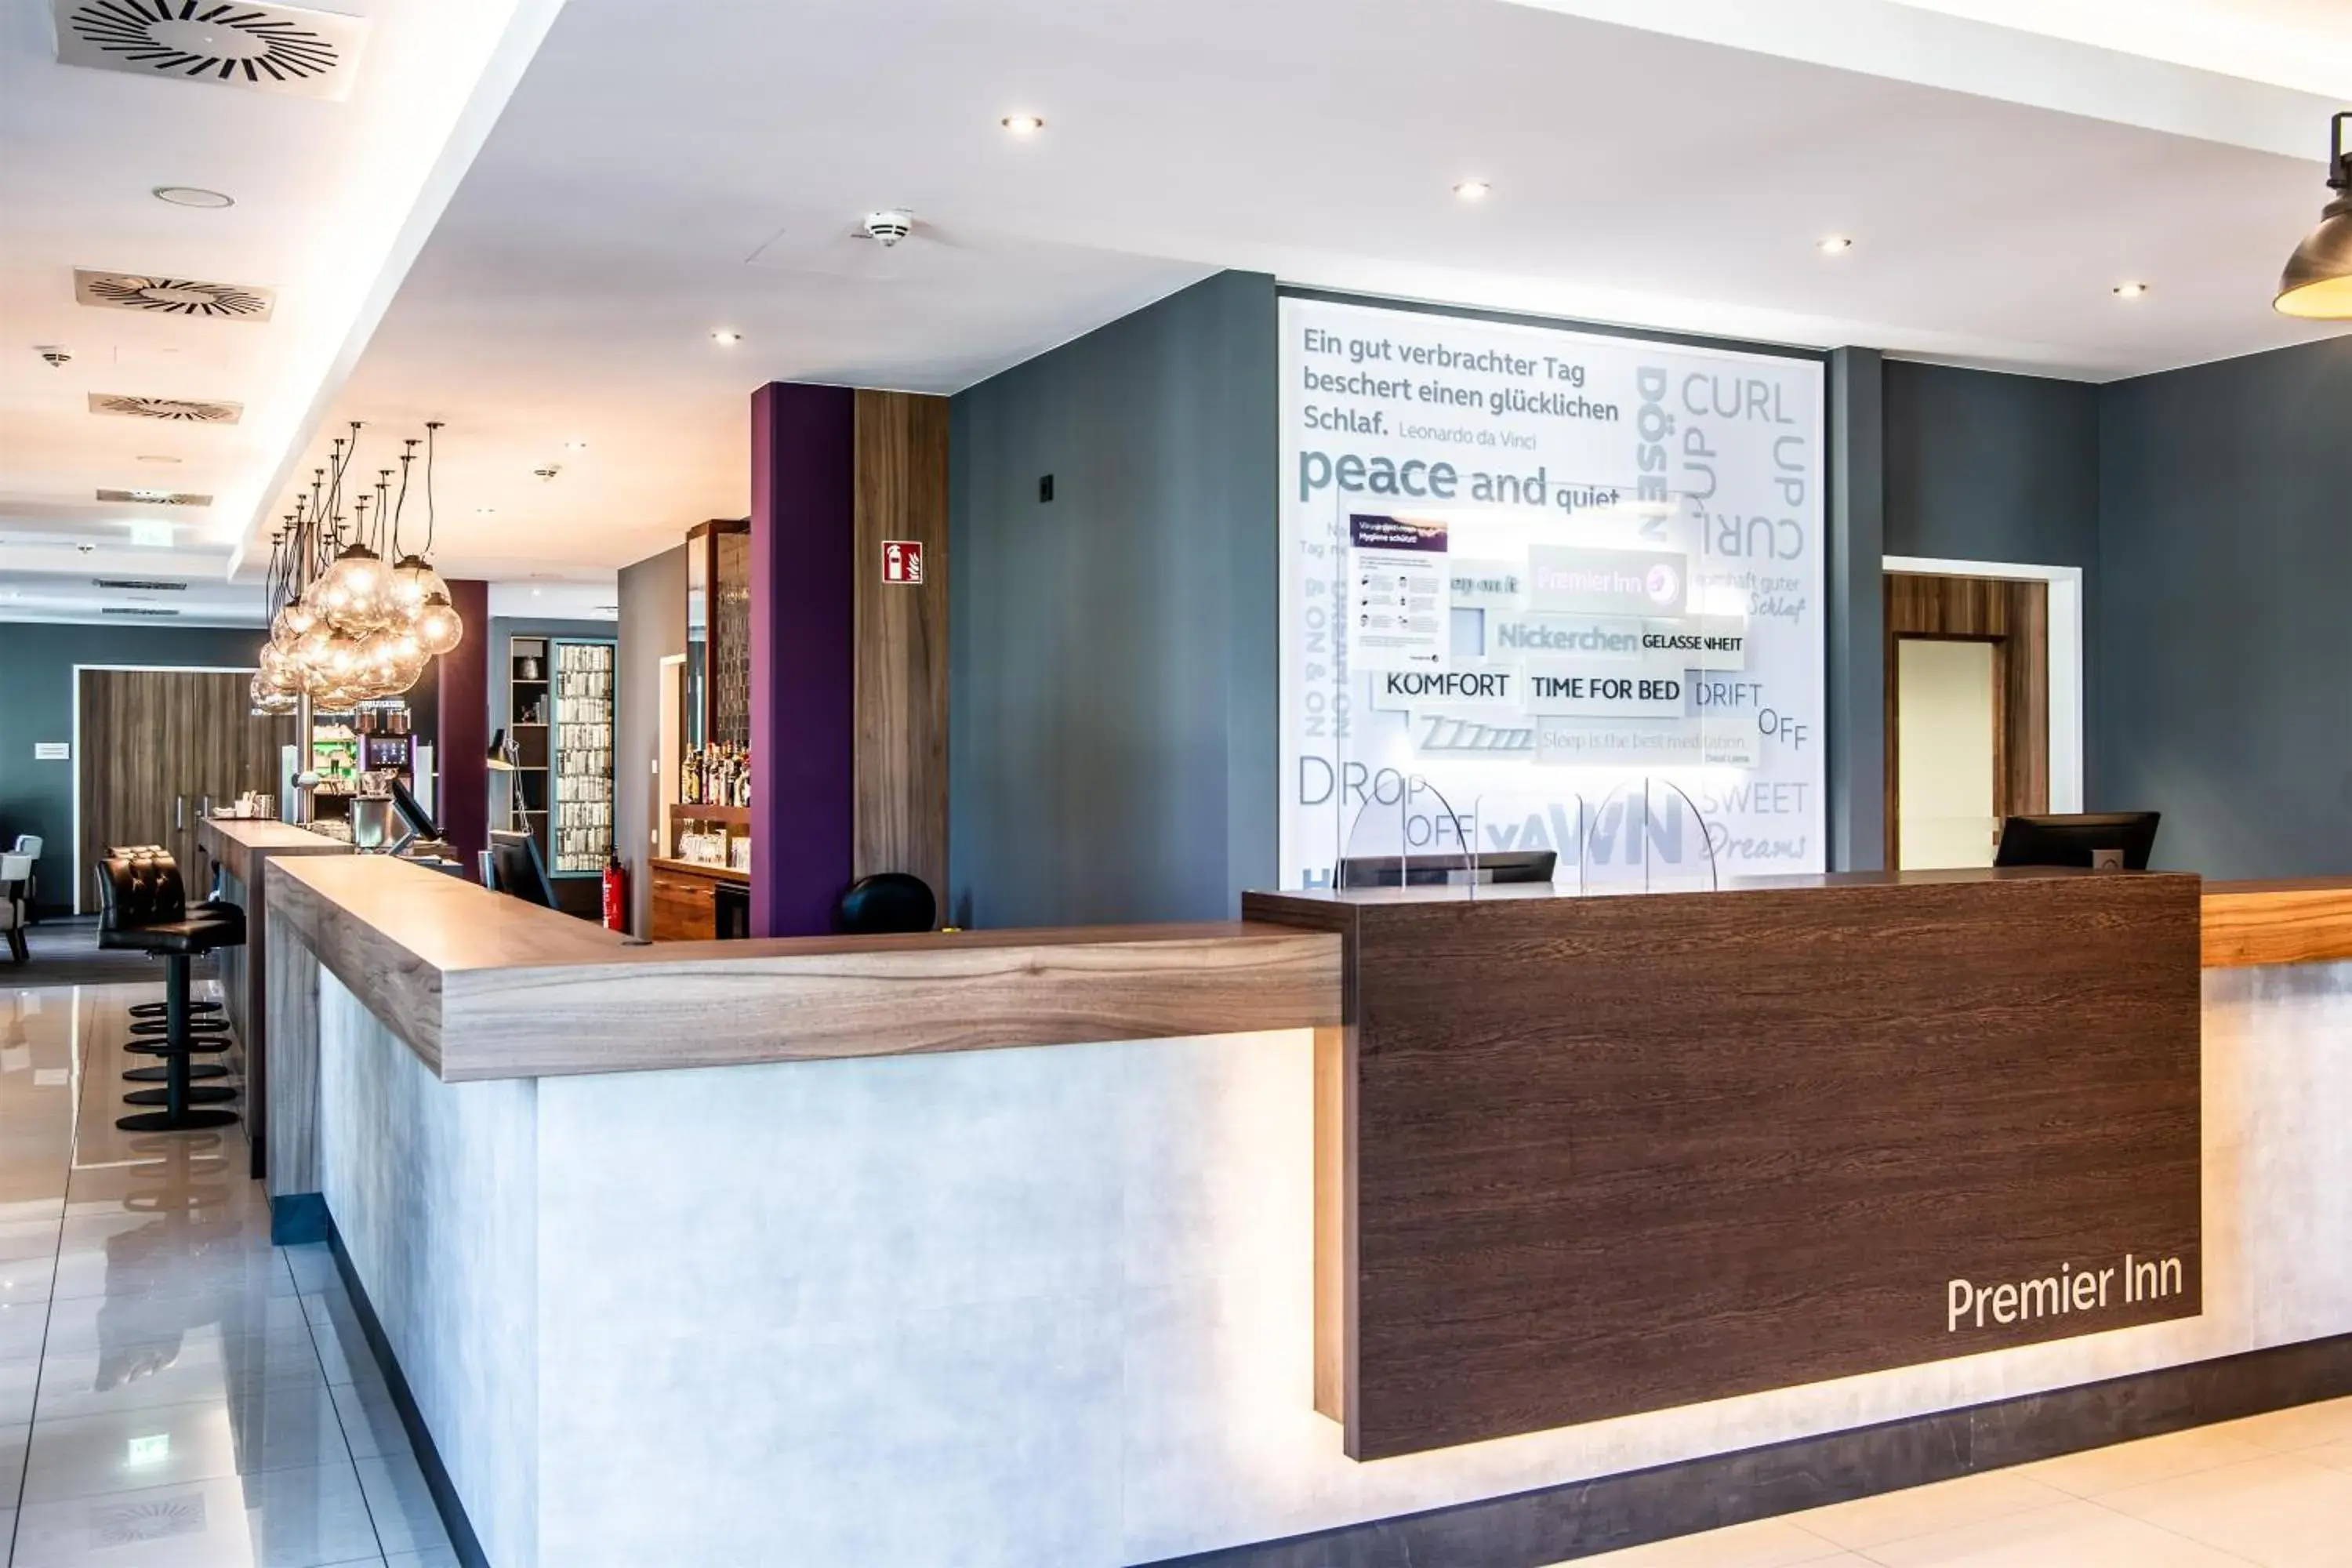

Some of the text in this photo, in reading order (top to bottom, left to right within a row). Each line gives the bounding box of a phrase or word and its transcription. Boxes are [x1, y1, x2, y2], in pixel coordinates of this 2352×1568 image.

[1304, 328, 1584, 388] Ein gut verbrachter Tag
[1304, 365, 1618, 421] beschert einen glücklichen
[1682, 372, 1795, 424] CURL
[1304, 405, 1388, 436] Schlaf.
[1399, 421, 1537, 452] Leonardo da Vinci
[1300, 451, 1620, 514] peace and quiet
[1773, 435, 1806, 507] UP
[1537, 565, 1642, 593] Premier Inn
[1497, 622, 1638, 652] Nickerchen
[1642, 634, 1743, 652] GELASSENHEIT
[1387, 672, 1510, 697] KOMFORT
[1531, 677, 1680, 700] TIME FOR BED
[1696, 682, 1763, 706] DRIFT
[1667, 732, 1745, 750] medtation
[1759, 708, 1808, 750] OFF
[1300, 756, 1427, 806] DROP
[1701, 782, 1809, 815] SWEET
[1406, 815, 1475, 847] OFF
[1698, 821, 1807, 860] Dreams
[1948, 1254, 2182, 1332] Premier Inn
